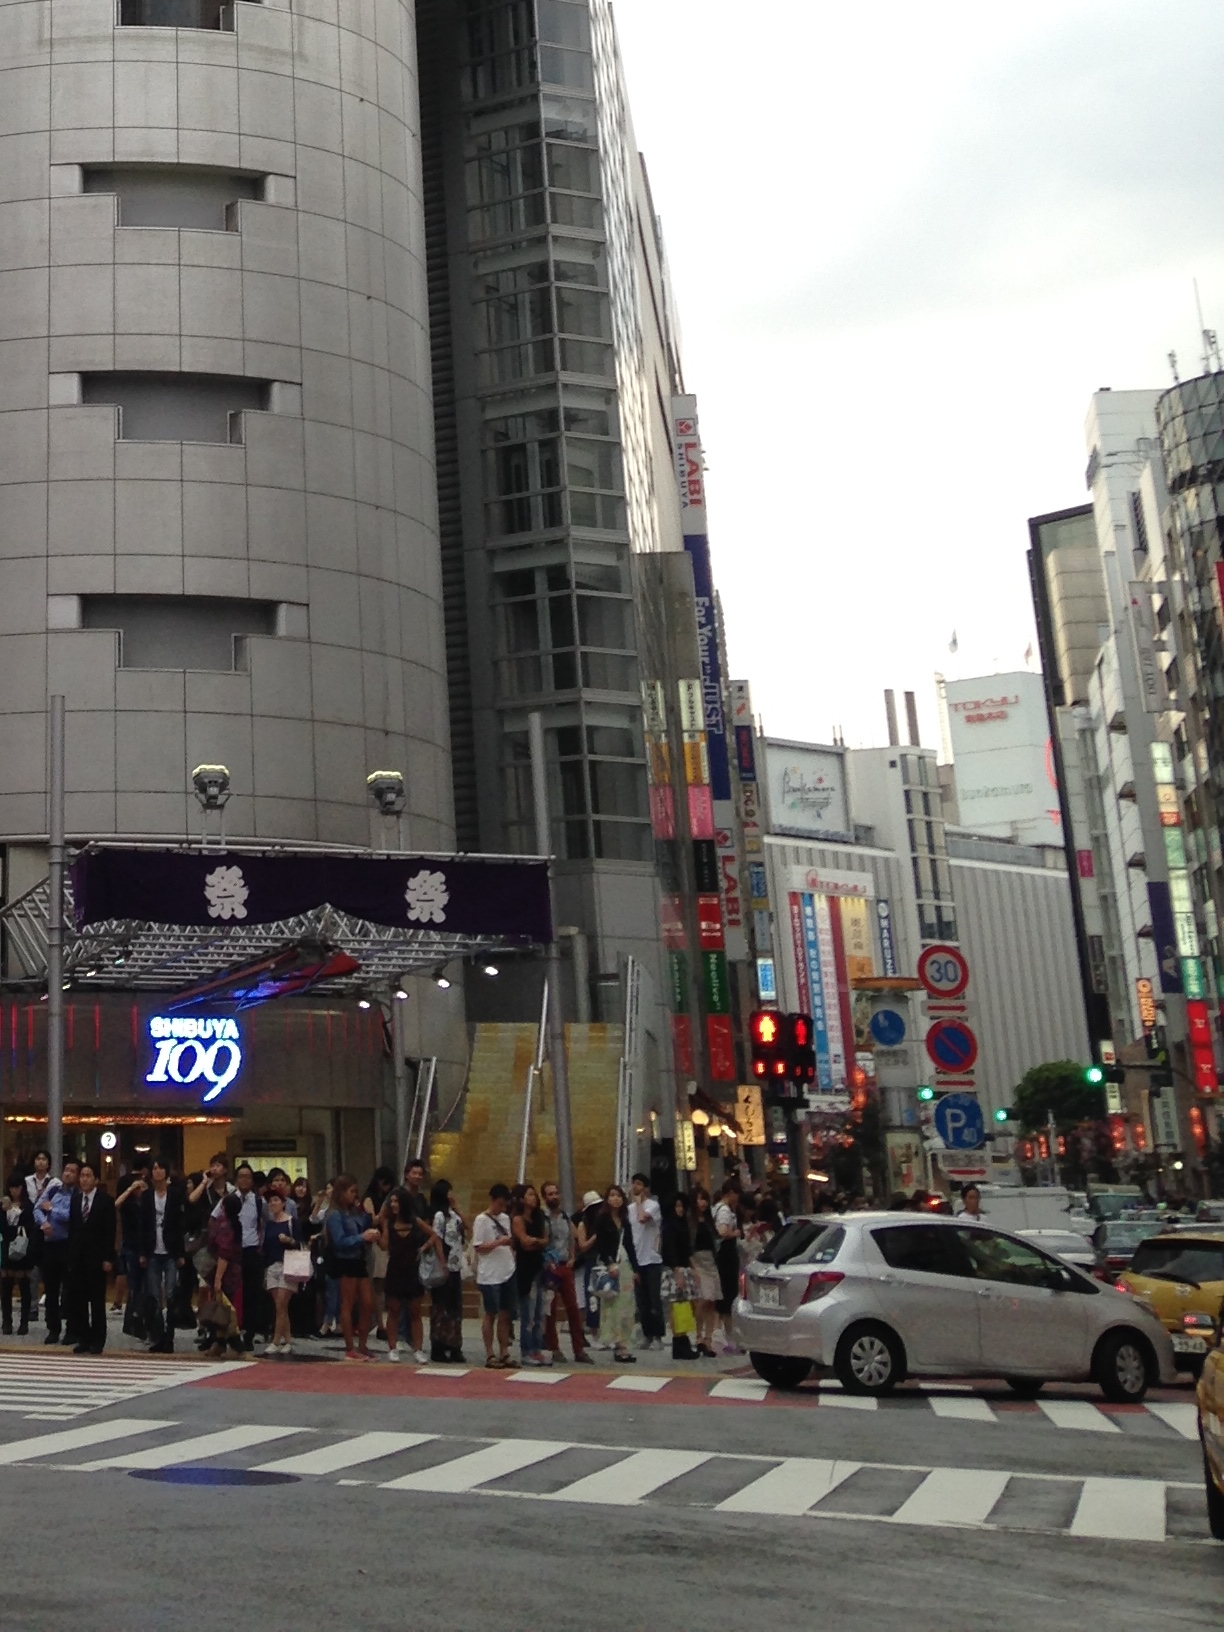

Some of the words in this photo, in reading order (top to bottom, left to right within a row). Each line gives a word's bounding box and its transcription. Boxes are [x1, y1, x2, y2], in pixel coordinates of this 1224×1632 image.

[677, 443, 689, 509] SHIBUYA
[684, 442, 702, 506] LABI
[694, 596, 710, 624] For
[203, 864, 251, 921] 祭
[404, 869, 451, 924] 祭
[721, 855, 741, 927] LABI
[929, 959, 960, 983] 30
[149, 1016, 240, 1039] SHIBUYA
[146, 1038, 241, 1101] 109
[945, 1108, 967, 1142] P
